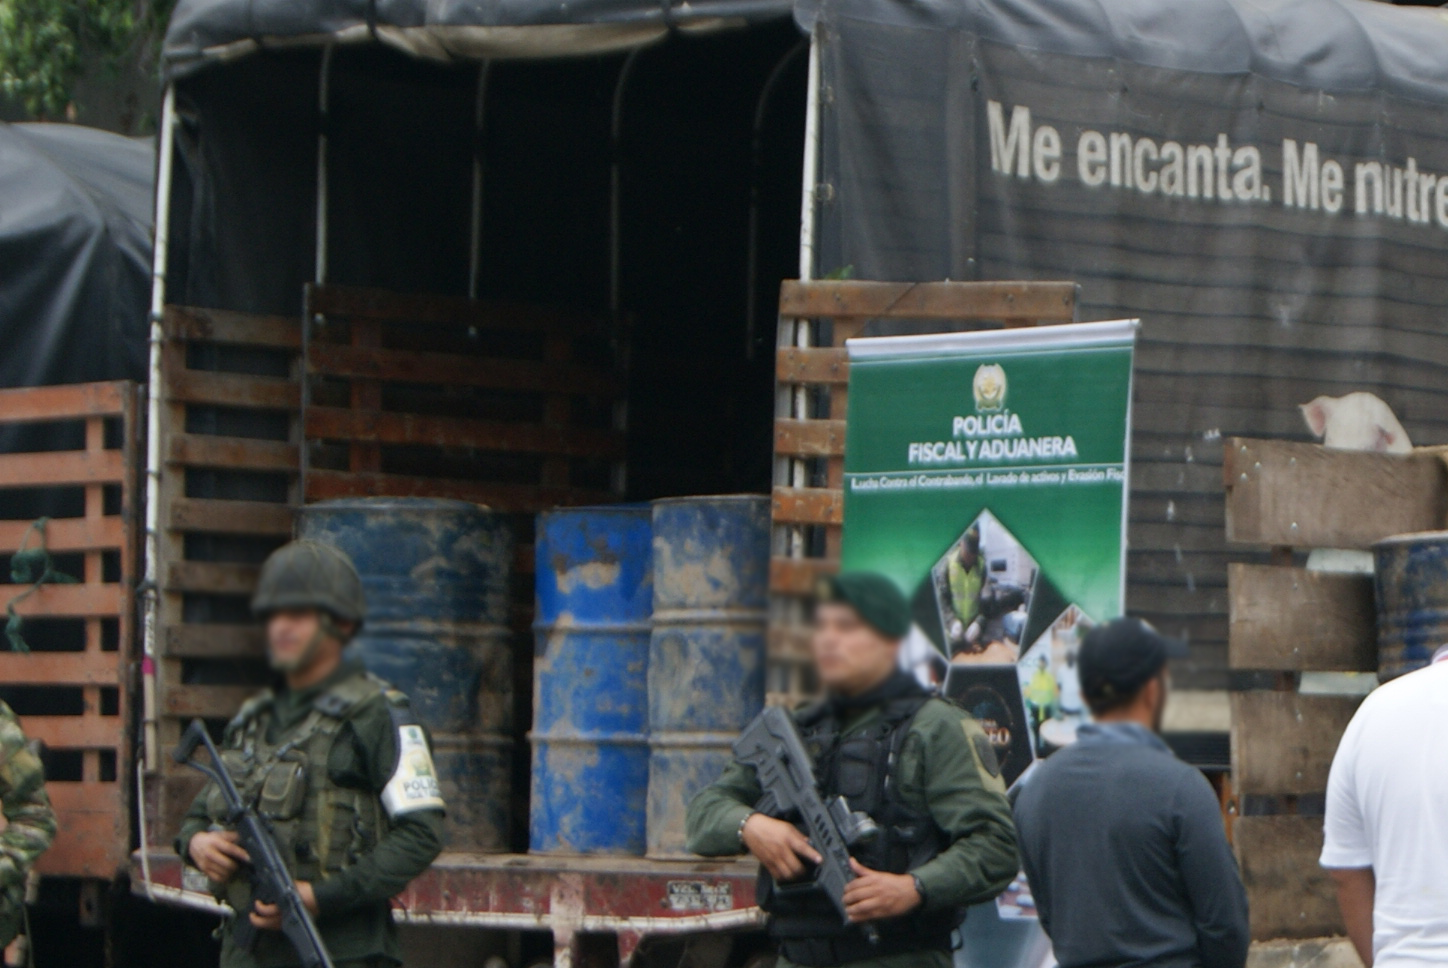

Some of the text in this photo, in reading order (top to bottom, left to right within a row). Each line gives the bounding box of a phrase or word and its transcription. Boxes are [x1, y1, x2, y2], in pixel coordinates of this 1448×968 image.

[987, 99, 1062, 182] Me
[1077, 131, 1270, 202] encanta.
[1283, 138, 1344, 213] Me
[952, 408, 1023, 436] POLICÍA
[908, 436, 1078, 462] FISCAL Y ADUANERA
